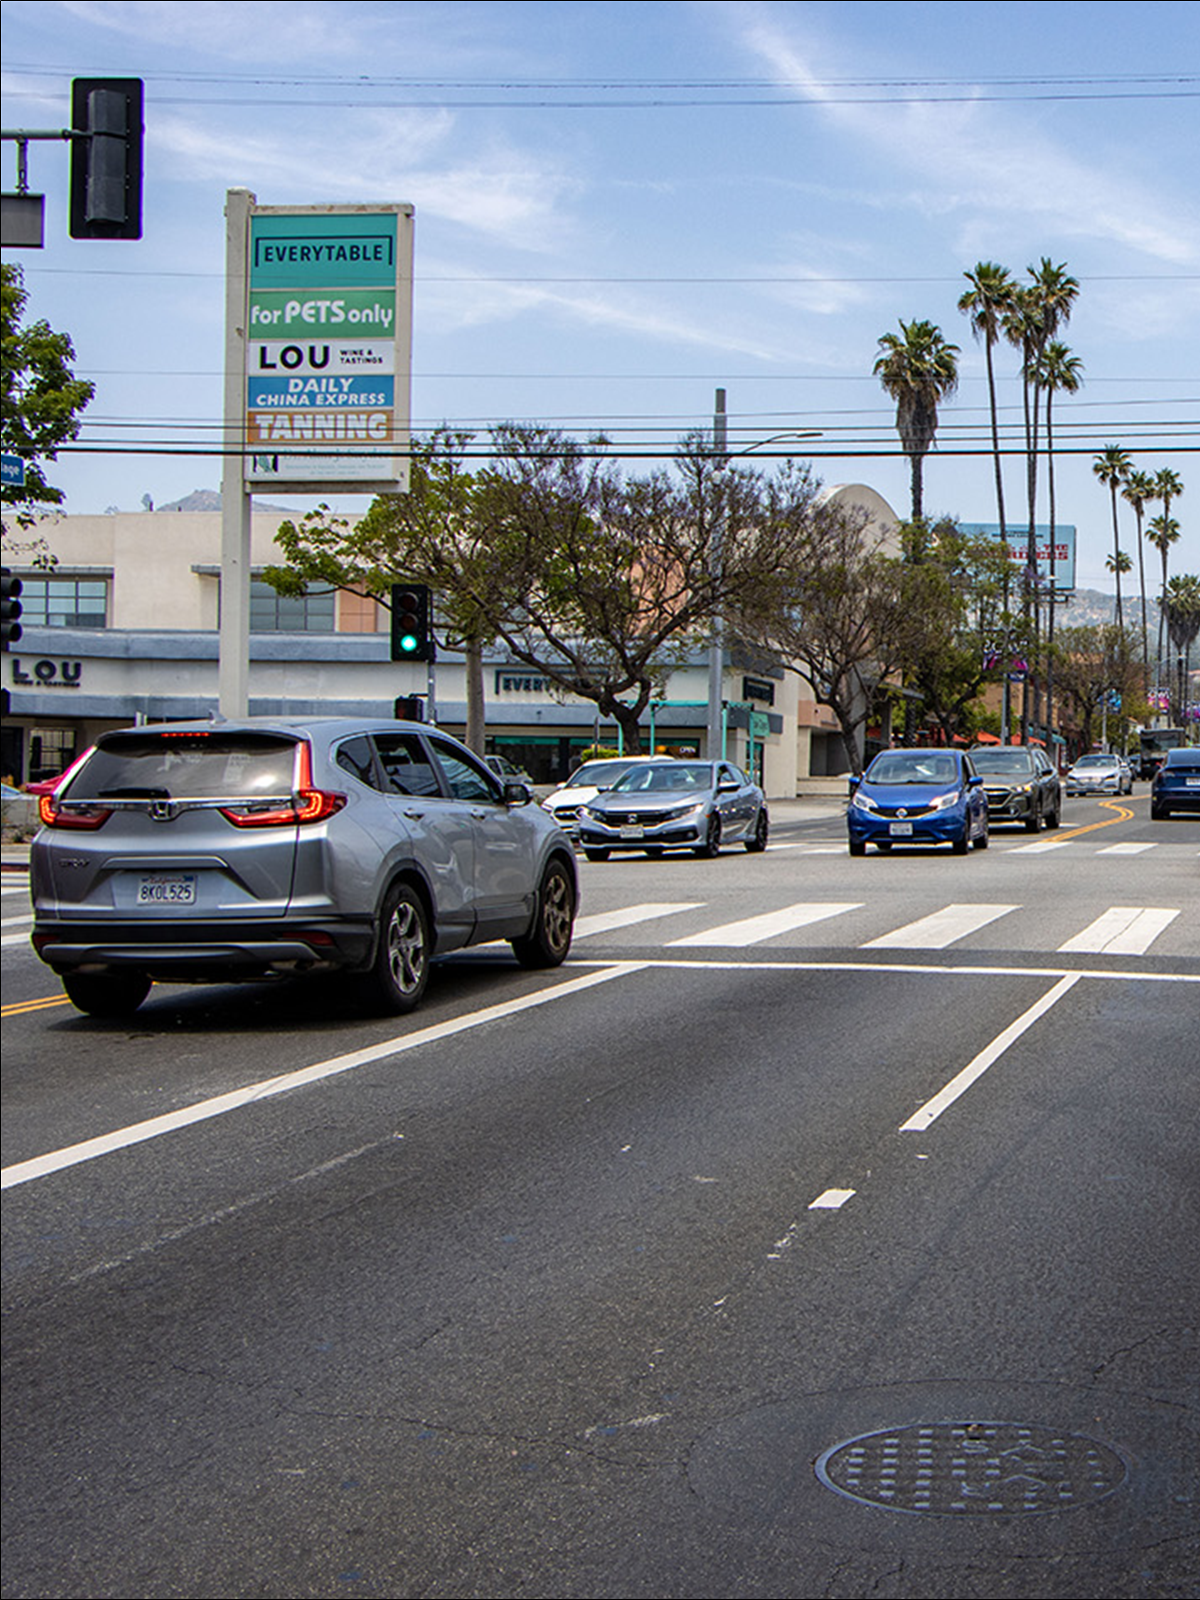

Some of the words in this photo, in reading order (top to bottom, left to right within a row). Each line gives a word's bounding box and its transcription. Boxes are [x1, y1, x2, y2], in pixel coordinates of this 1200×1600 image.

[264, 244, 383, 262] EVERYTABLE
[251, 305, 282, 324] for
[284, 300, 346, 324] PETS
[347, 303, 393, 328] only
[259, 344, 330, 370] LOU
[340, 356, 384, 365] TASTINGS
[288, 377, 355, 393] DAILY
[256, 394, 310, 406] CHINA
[315, 392, 386, 406] EXPRESS
[255, 412, 388, 440] TANNING
[12, 659, 82, 682] LOU
